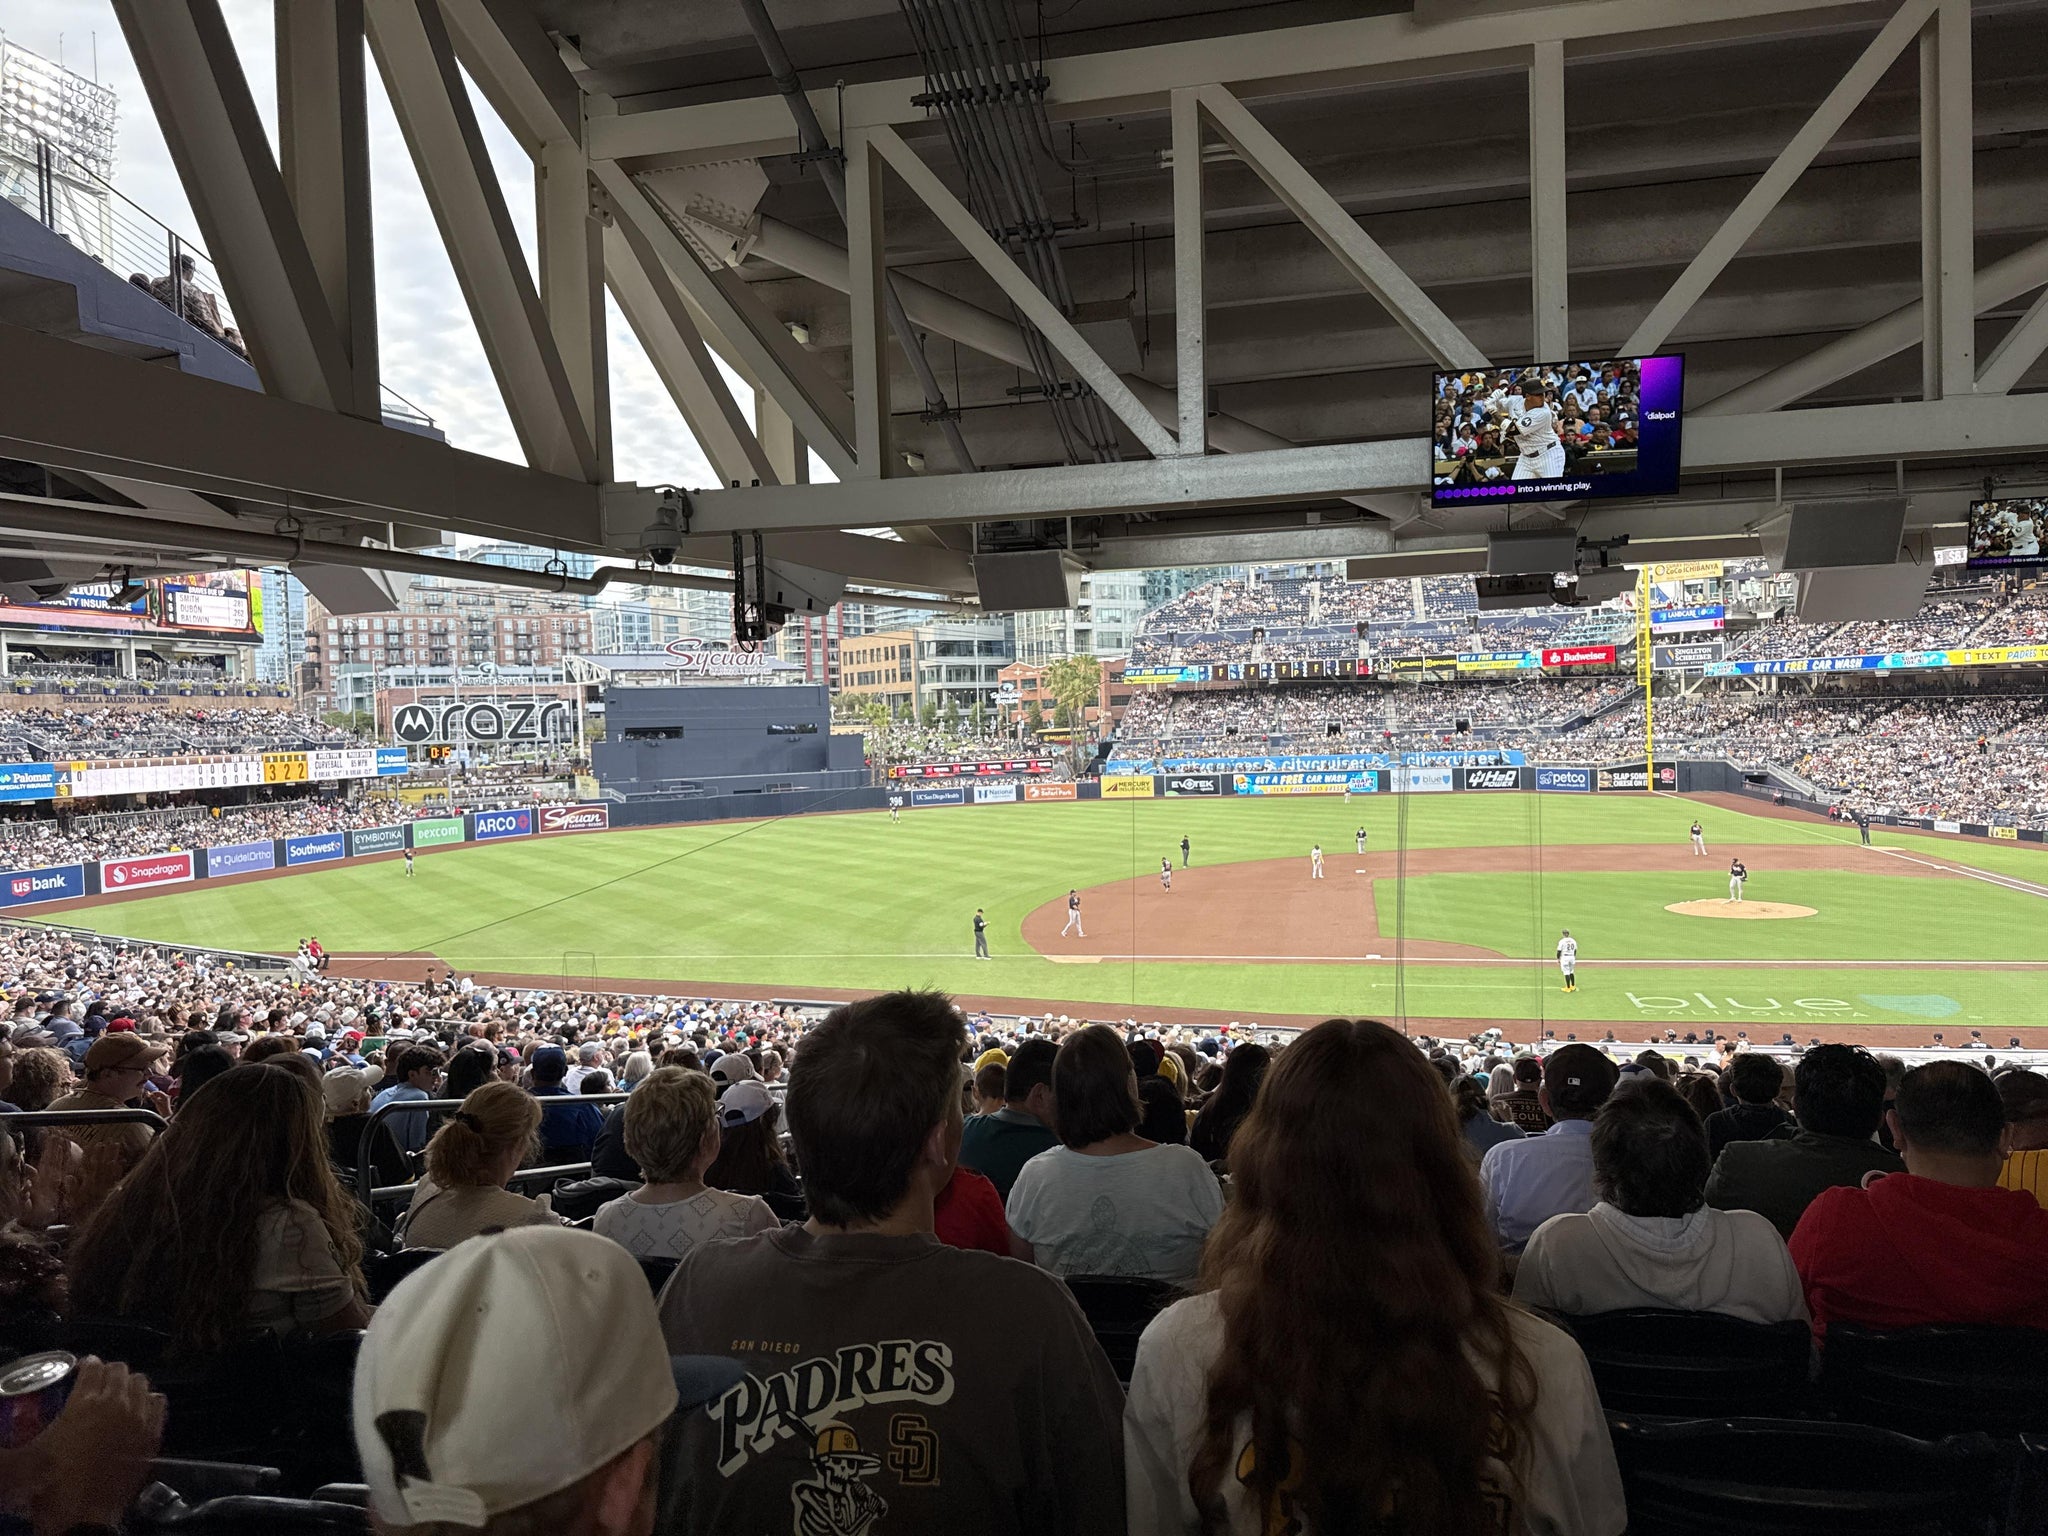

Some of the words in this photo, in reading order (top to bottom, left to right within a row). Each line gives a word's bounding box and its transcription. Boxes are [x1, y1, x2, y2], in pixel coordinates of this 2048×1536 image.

[1648, 411, 1675, 421] dialpad
[1518, 485, 1534, 493] into
[1541, 483, 1572, 492] winning
[1573, 482, 1592, 491] play.
[1684, 563, 1718, 573] ICHIBANYA
[168, 593, 172, 601] 4
[181, 614, 210, 624] BALDWIN
[1668, 609, 1696, 618] LANDCARE
[664, 638, 768, 675] Sycuan
[1564, 652, 1606, 662] Budweiser
[1674, 653, 1712, 661] SCHREIBER
[1976, 652, 2000, 660] TEXT
[2007, 649, 2036, 660] PADRES
[1754, 663, 1770, 673] GET
[1773, 663, 1780, 672] A
[1785, 661, 1808, 672] FREE
[1812, 660, 1832, 670] CAR
[1835, 658, 1863, 669] WASH
[450, 676, 497, 685] Gallagher
[498, 676, 528, 685] Square
[441, 702, 563, 741] razr
[431, 746, 450, 758] 0:15
[314, 760, 342, 769] CURVEBALL
[270, 764, 276, 780] 3
[284, 764, 290, 779] 2
[298, 763, 304, 779] 2
[13, 773, 52, 783] Palomar
[1172, 778, 1214, 790] EVOTEK
[1255, 776, 1270, 784] GET
[1280, 774, 1303, 784] FREE
[1306, 775, 1322, 783] CAR
[1324, 774, 1347, 783] WASH
[1393, 776, 1411, 784] blue
[1422, 775, 1442, 783] blue
[1553, 772, 1586, 784] petco
[478, 816, 516, 833] ARCO
[544, 809, 601, 829] Sycuan
[355, 830, 402, 844] CYMBIOTIKA
[290, 841, 335, 857] Southwest
[224, 851, 271, 865] QuidelOrtho
[131, 862, 183, 878] Snapdragon
[14, 882, 30, 892] us
[32, 874, 66, 890] bank
[1624, 992, 1853, 1010] blue
[1641, 1009, 1870, 1018] CALIFORNIA
[1513, 1112, 1541, 1120] EOUL
[731, 1340, 754, 1351] SAN
[761, 1341, 800, 1354] DIEGO
[706, 1340, 954, 1478] PADRES
